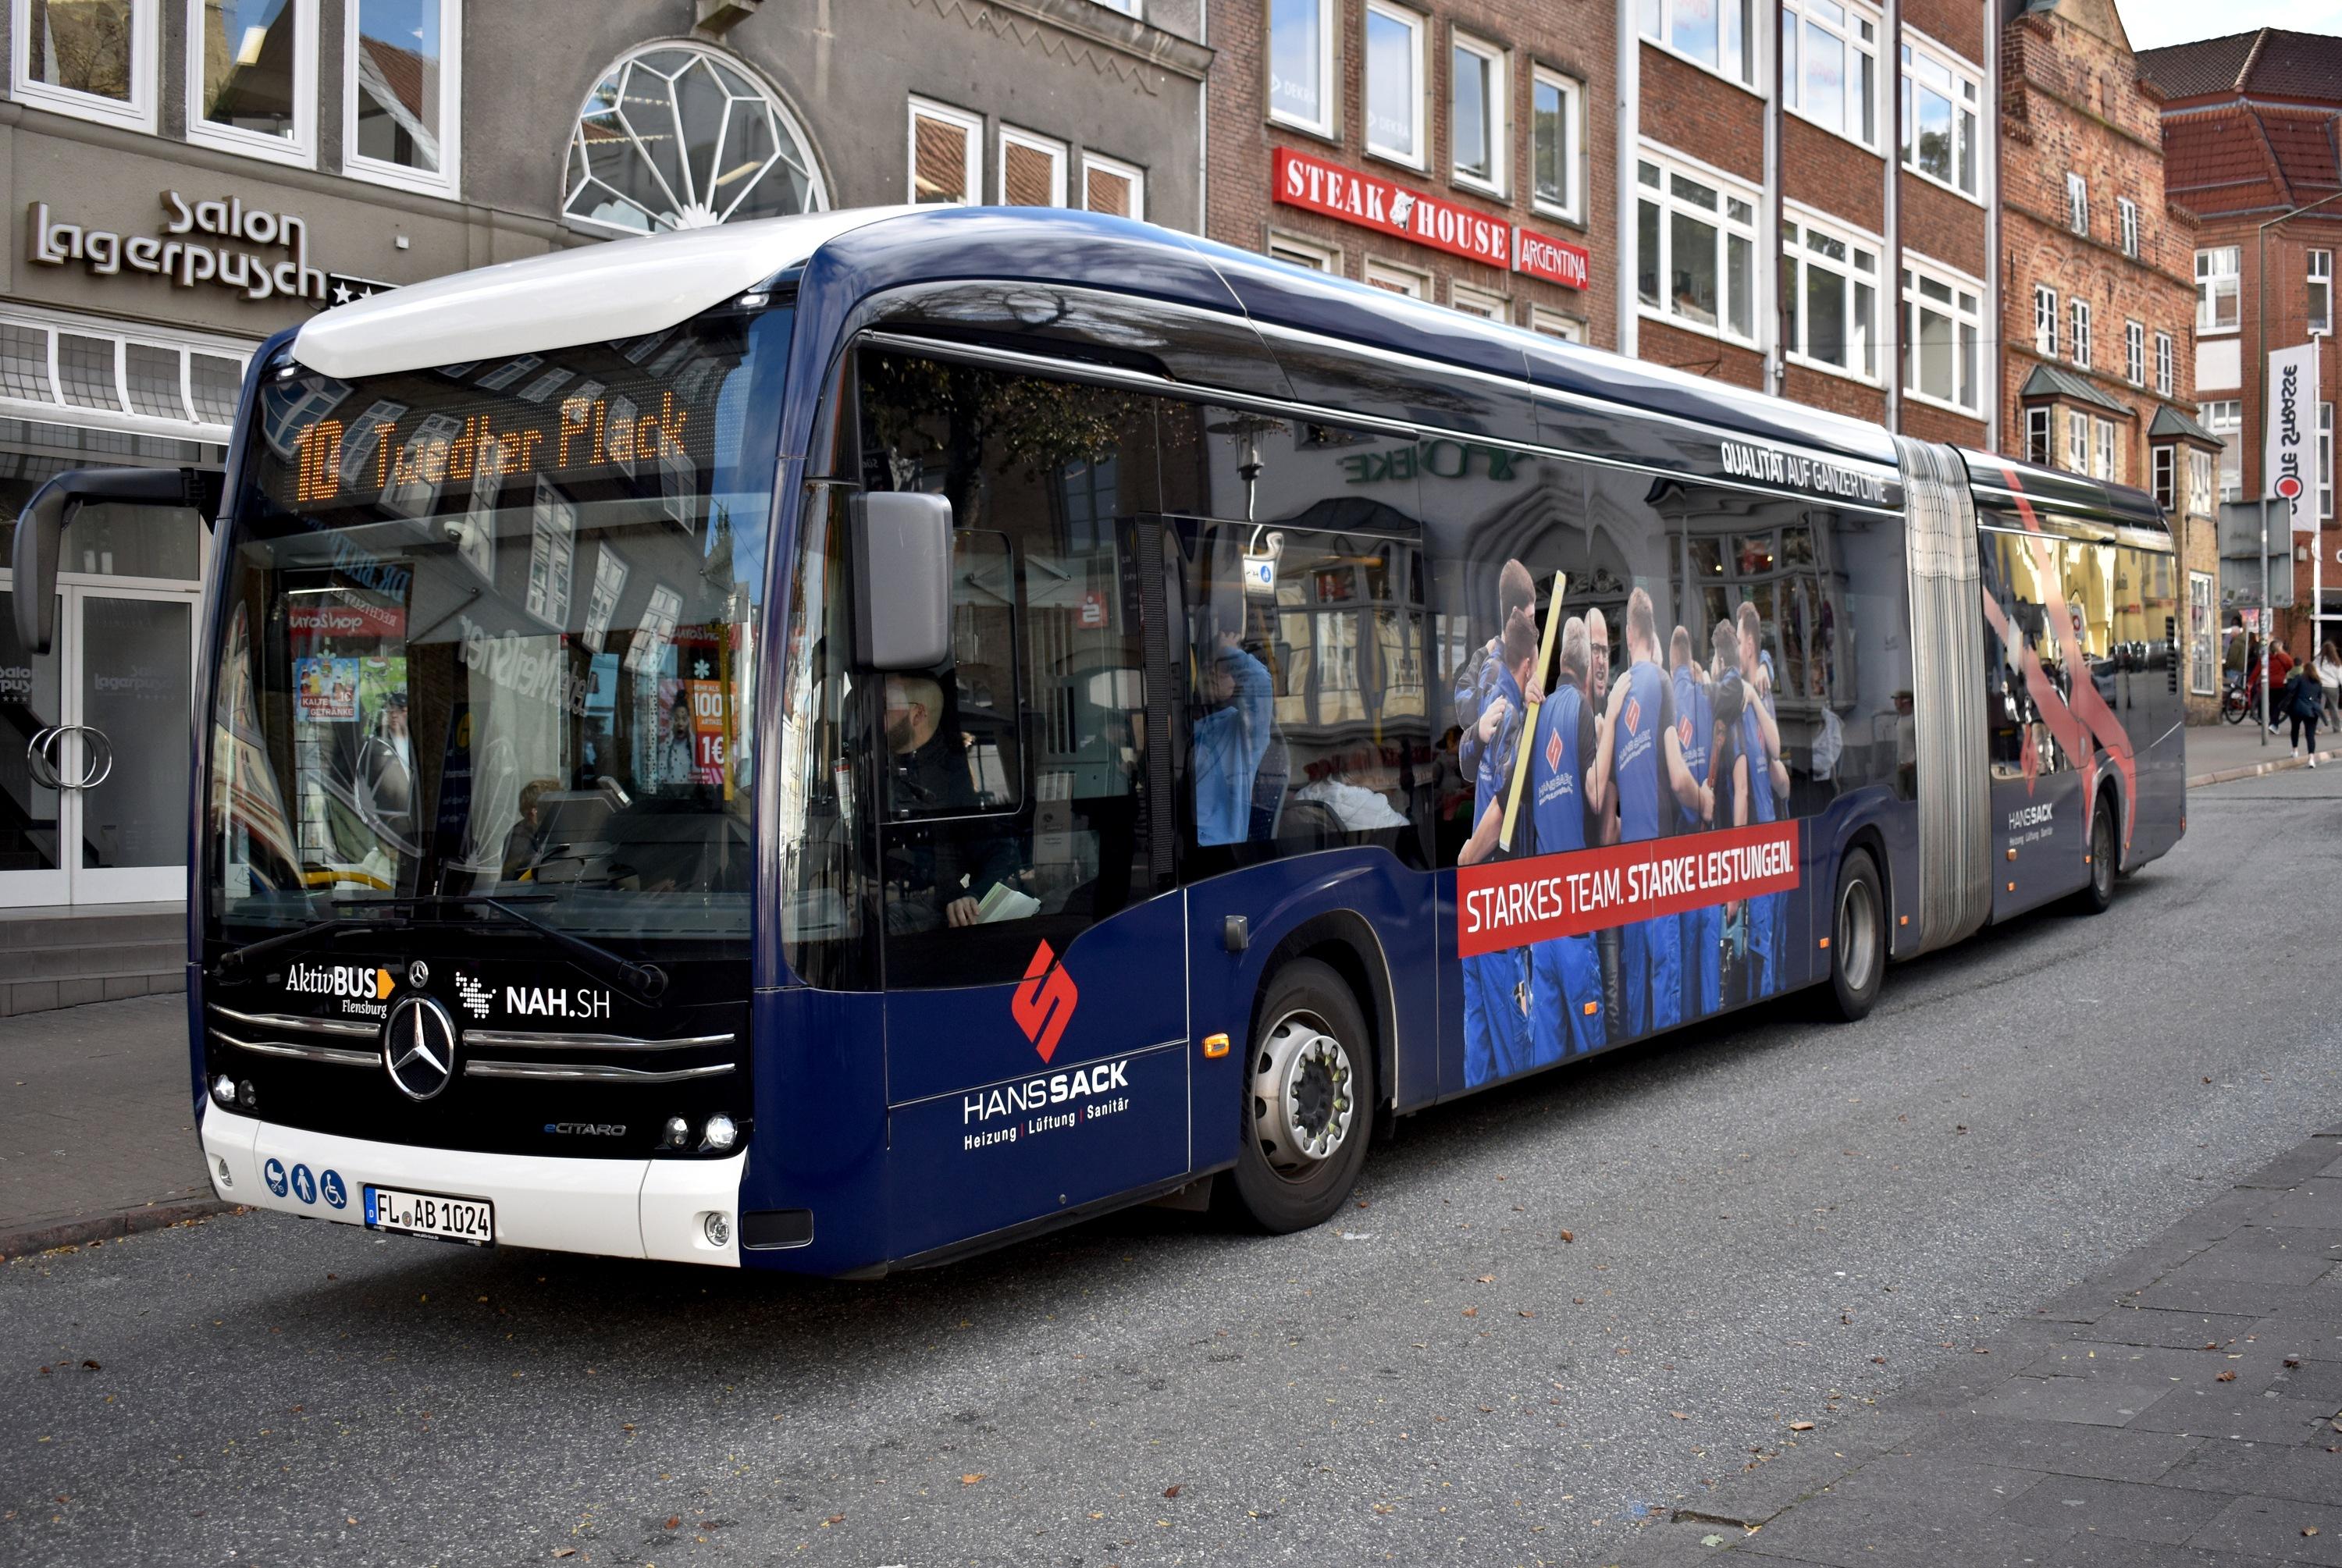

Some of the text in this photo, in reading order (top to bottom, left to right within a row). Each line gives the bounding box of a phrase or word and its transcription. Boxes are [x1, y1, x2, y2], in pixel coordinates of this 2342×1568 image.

[1284, 81, 1317, 105] DEKRA
[1379, 116, 1409, 138] DEKRA
[1287, 159, 1506, 261] STEAK HOUSE
[1522, 236, 1586, 287] ARGENTINA
[292, 391, 687, 502] 10 Twedter Plack
[1721, 441, 1888, 503] QUALITÄT AUF GANZER LINIE
[302, 697, 330, 706] KALTE
[310, 705, 354, 716] GETRÄNKE
[1466, 839, 1794, 933] STARKES TEAM. STARKE LEISTUNGEN.
[286, 963, 377, 998] AktivBUS
[342, 999, 387, 1019] Flensburg
[506, 987, 610, 1018] NAH.SH
[964, 1097, 1130, 1151] Heizung Lüftung Sanitär
[377, 1193, 400, 1224] FL
[415, 1199, 436, 1228] AB
[441, 1203, 489, 1236] 1024
